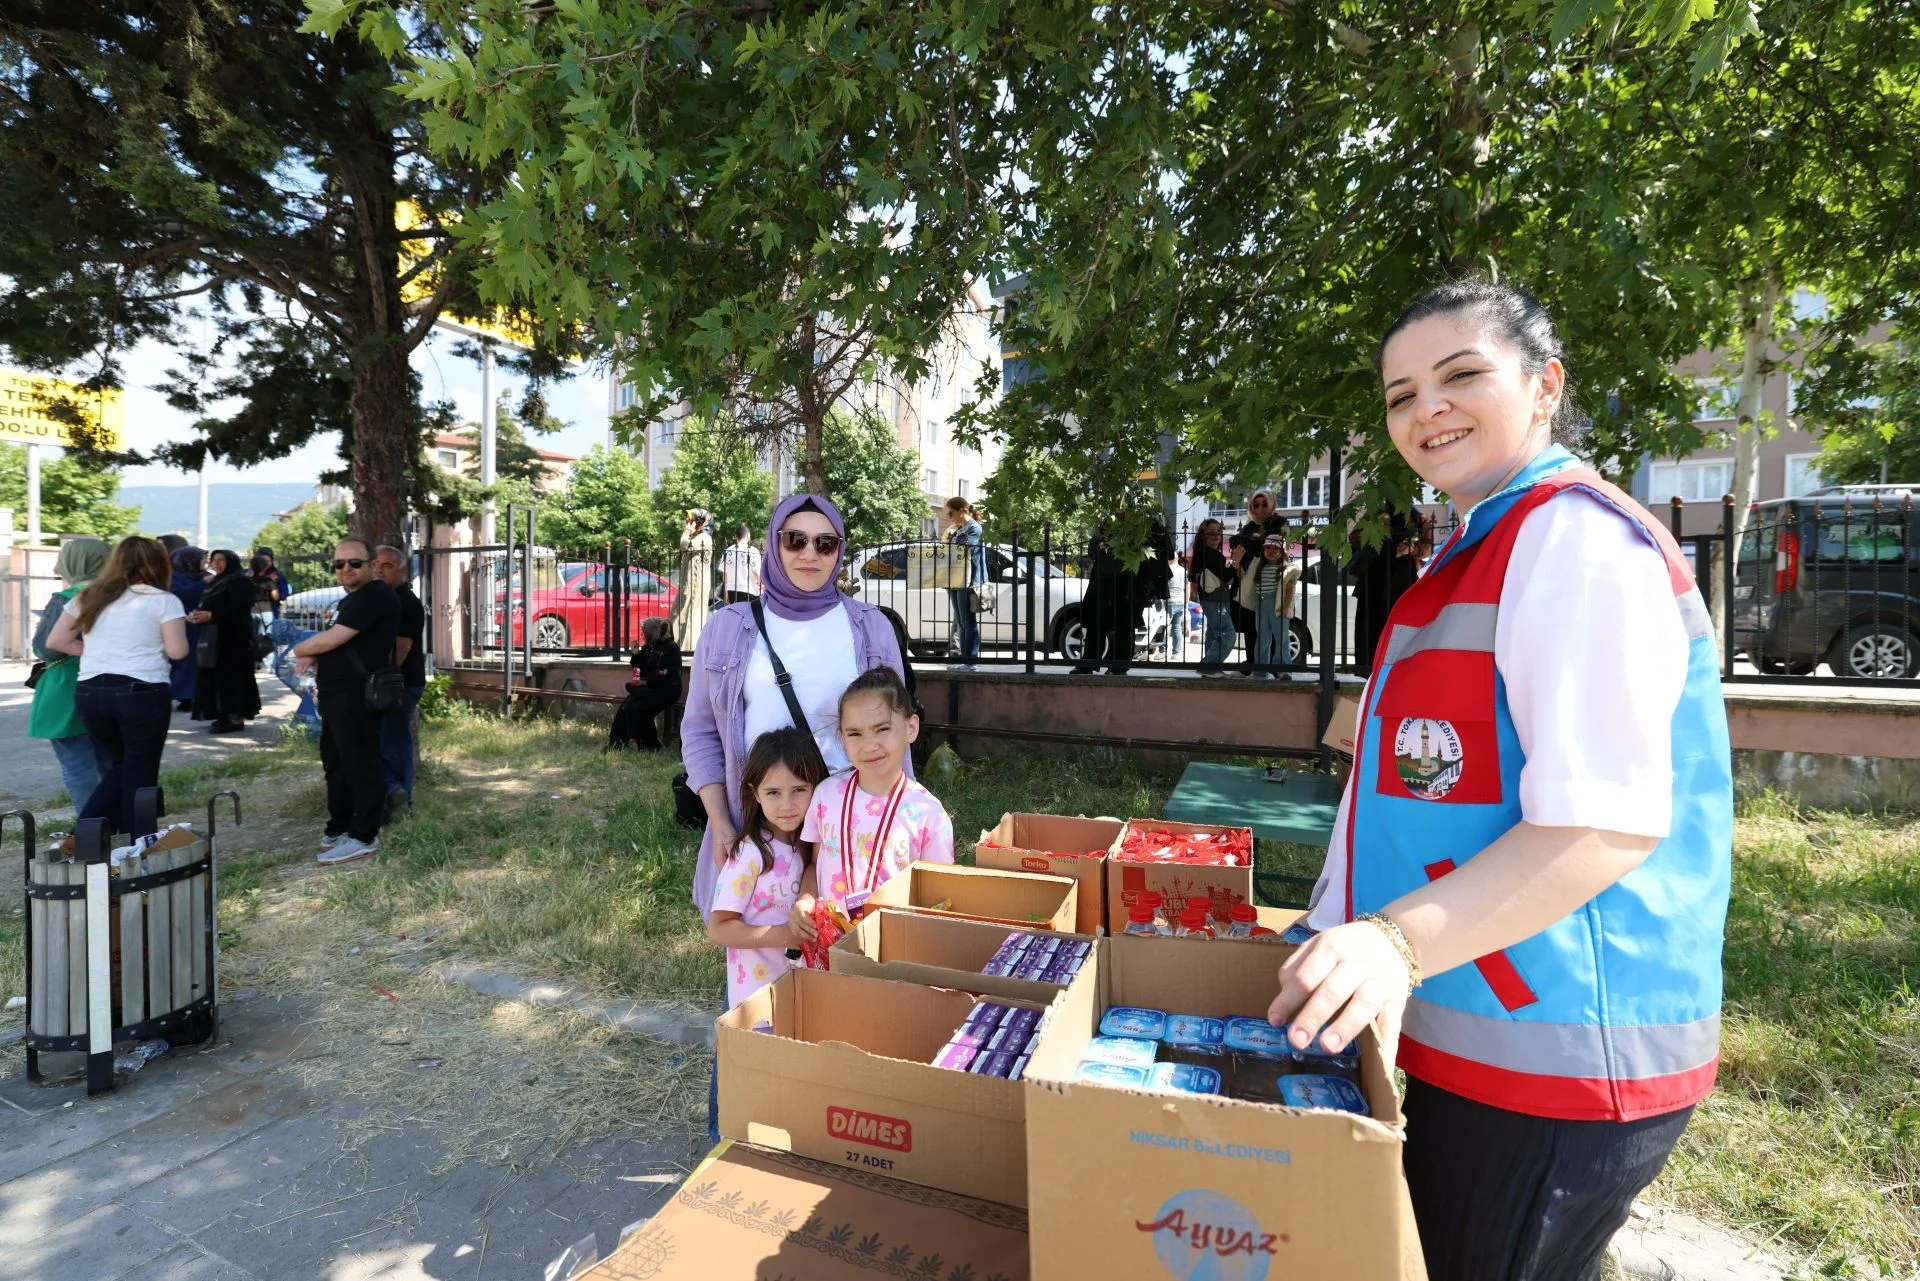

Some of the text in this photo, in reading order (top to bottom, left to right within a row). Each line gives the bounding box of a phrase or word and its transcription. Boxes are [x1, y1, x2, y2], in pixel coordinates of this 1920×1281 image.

[1023, 859, 1047, 869] Torku
[831, 1110, 907, 1146] DİMES
[1129, 1130, 1190, 1151] NİKSAR
[846, 1151, 895, 1171] 27 ADET
